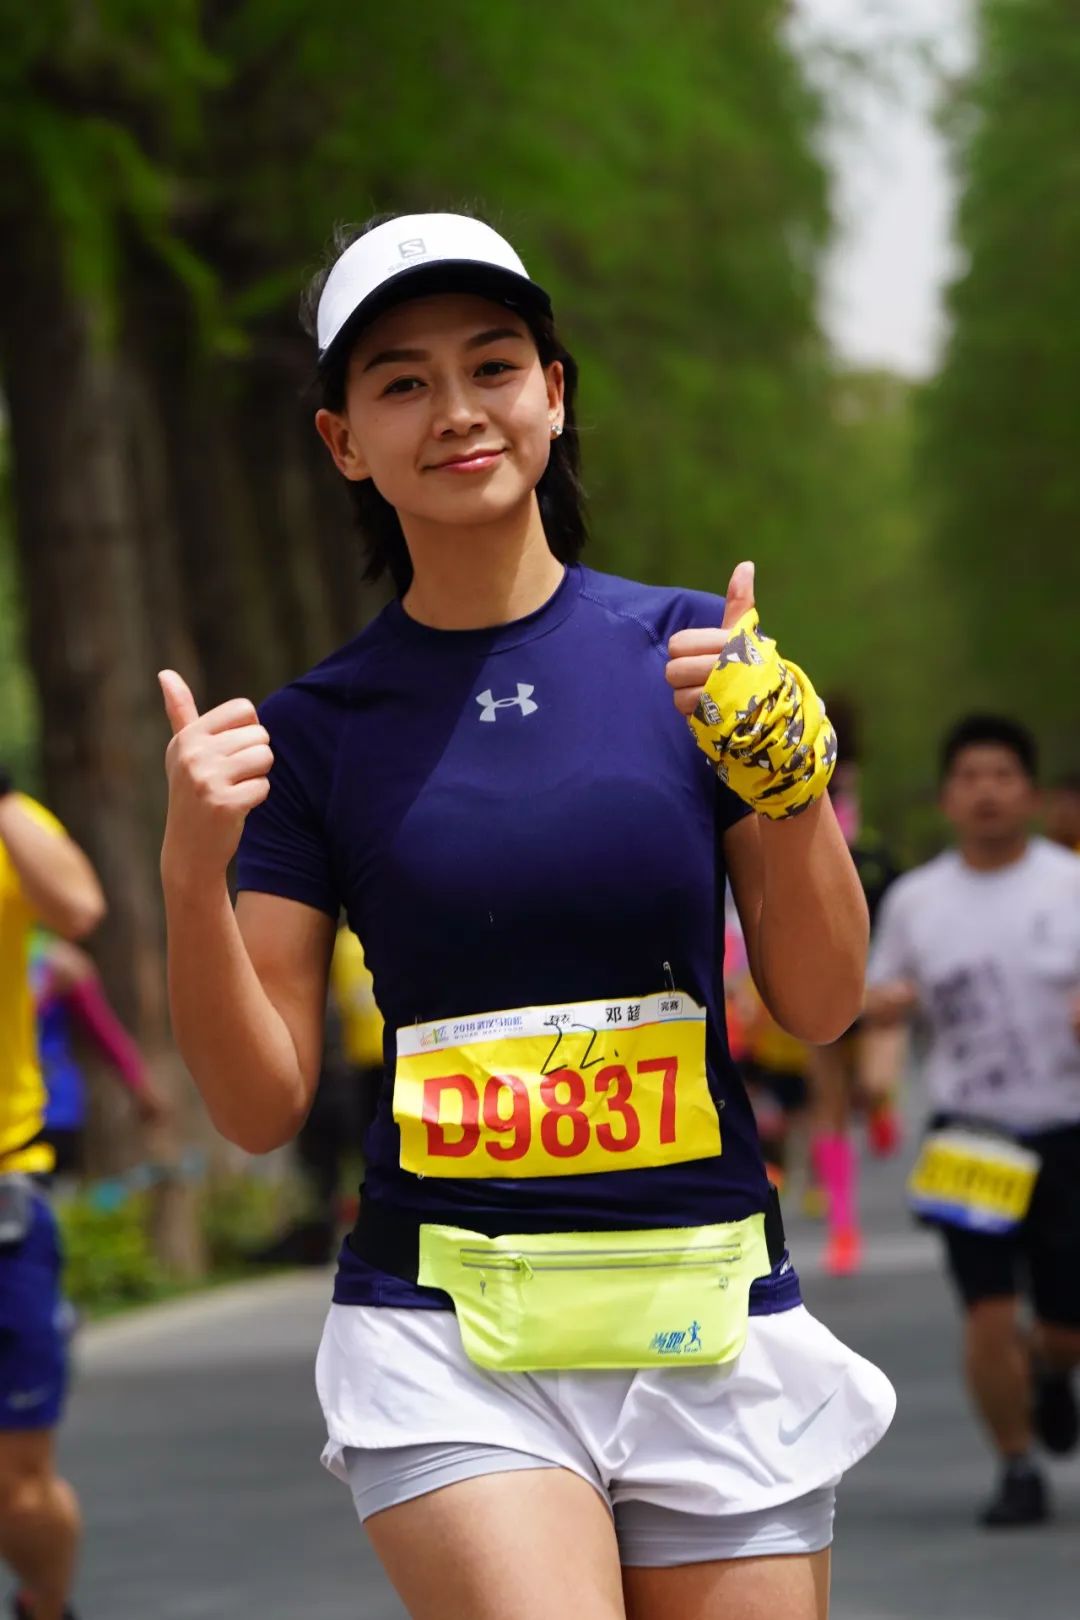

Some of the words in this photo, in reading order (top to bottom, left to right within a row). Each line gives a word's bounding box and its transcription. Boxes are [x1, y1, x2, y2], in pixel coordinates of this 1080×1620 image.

[605, 1004, 640, 1024] 邓超
[660, 1000, 680, 1012] 完赛
[421, 1056, 678, 1161] D9837
